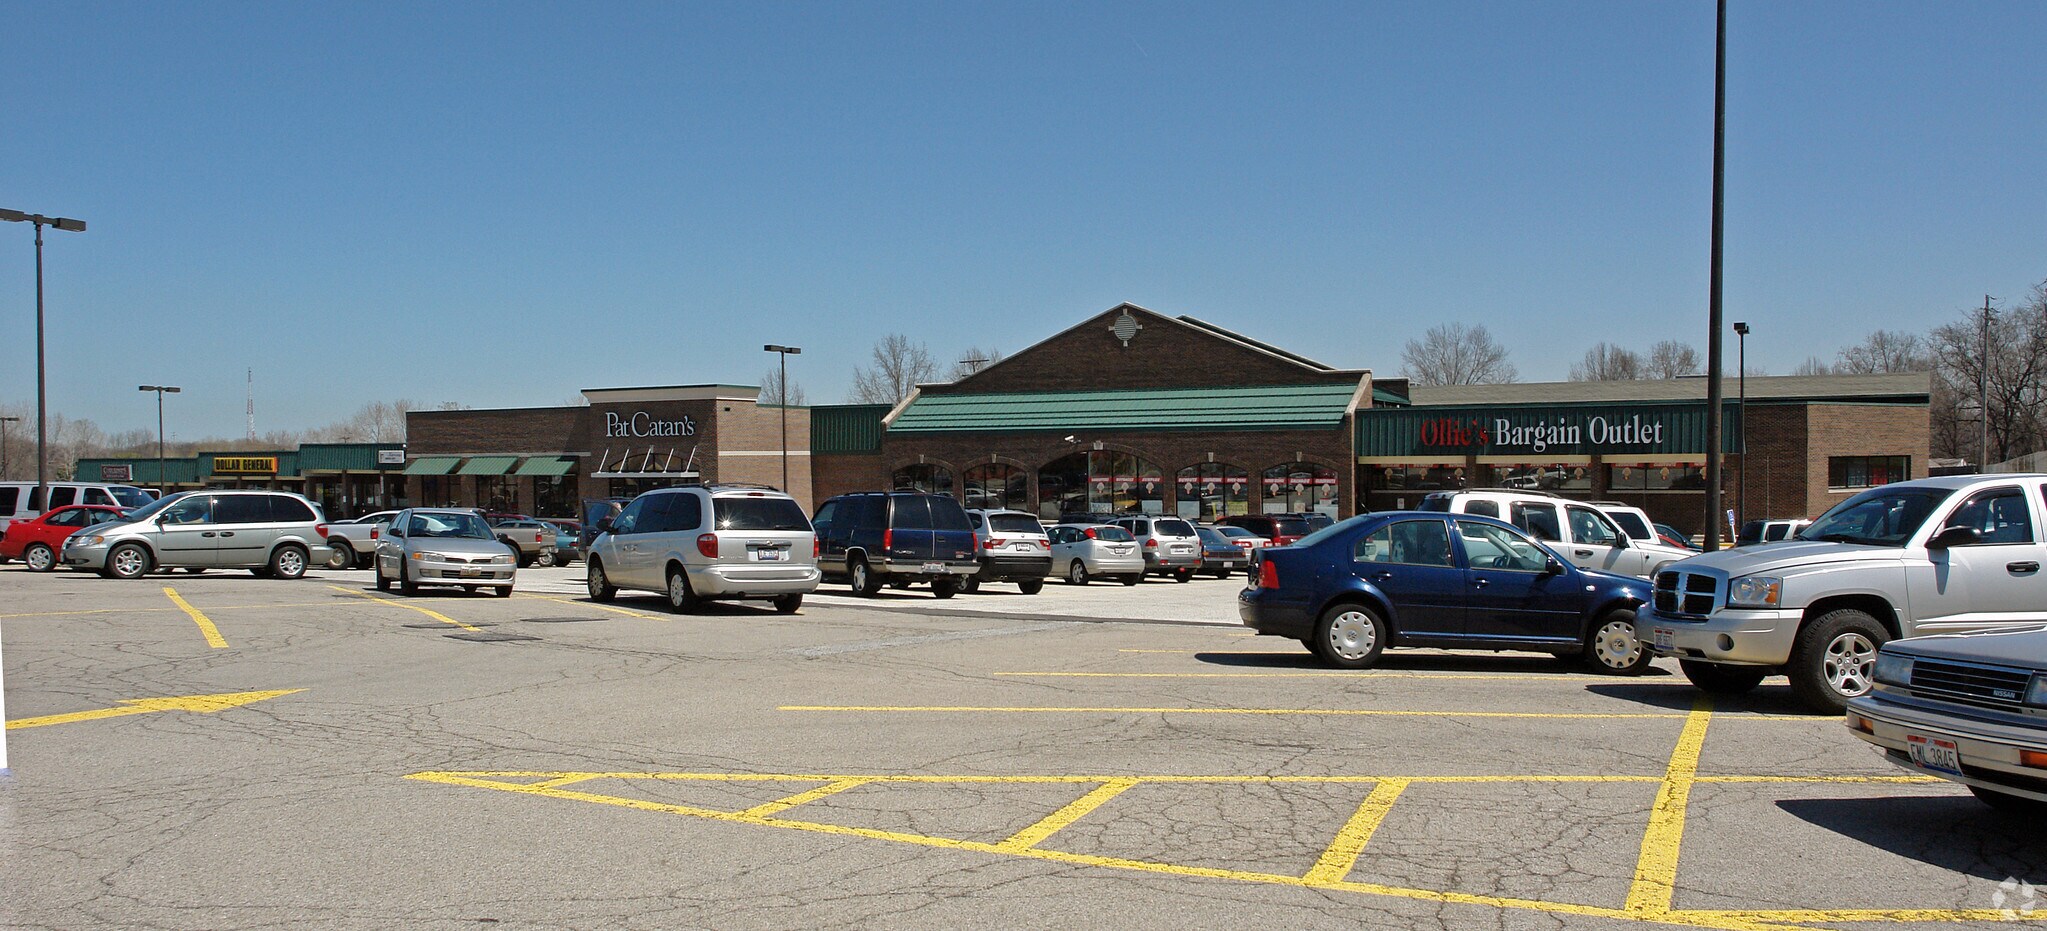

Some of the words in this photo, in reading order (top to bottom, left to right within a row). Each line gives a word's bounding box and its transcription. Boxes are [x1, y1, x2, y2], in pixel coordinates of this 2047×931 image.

[605, 412, 630, 437] Pat
[631, 411, 695, 437] Catan's
[1420, 419, 1490, 446] Ollie's
[1495, 417, 1581, 452] Bargain
[1589, 415, 1663, 444] Outlet
[215, 459, 240, 470] DOLLAR
[243, 459, 273, 470] GENERAL
[1993, 689, 2015, 699] NISSAN
[1930, 748, 1956, 769] 3845
